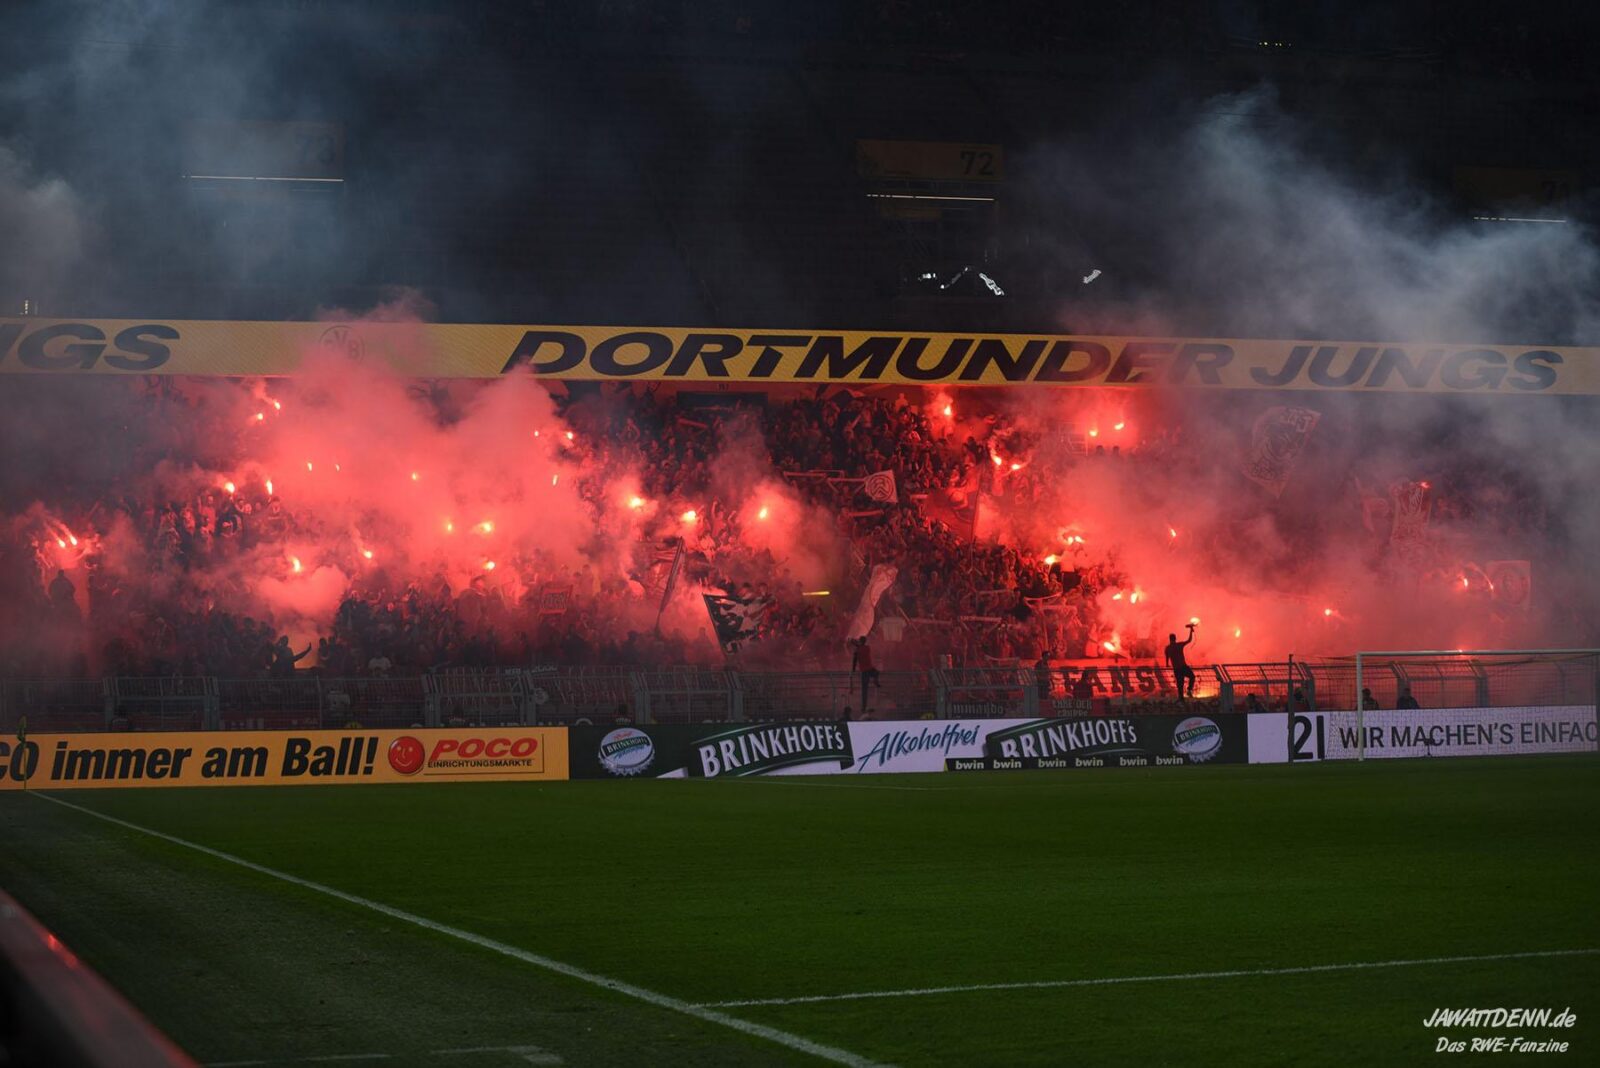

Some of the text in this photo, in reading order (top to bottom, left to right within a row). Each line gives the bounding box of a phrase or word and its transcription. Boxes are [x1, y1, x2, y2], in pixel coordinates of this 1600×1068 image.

[960, 151, 994, 175] 72
[500, 330, 1563, 391] DORTMUNDER JUNGS
[1339, 727, 1384, 749] WIR
[428, 737, 538, 761] POCO
[857, 723, 981, 773] Alkoholfrei
[51, 741, 192, 780] immer
[201, 747, 269, 778] am
[281, 737, 379, 776] Ball!
[955, 760, 985, 770] bwin
[993, 759, 1022, 769] bwin
[1038, 758, 1067, 768] bwin
[1075, 757, 1104, 767] bwin
[1119, 756, 1148, 767] bwin
[1156, 754, 1184, 766] bwin
